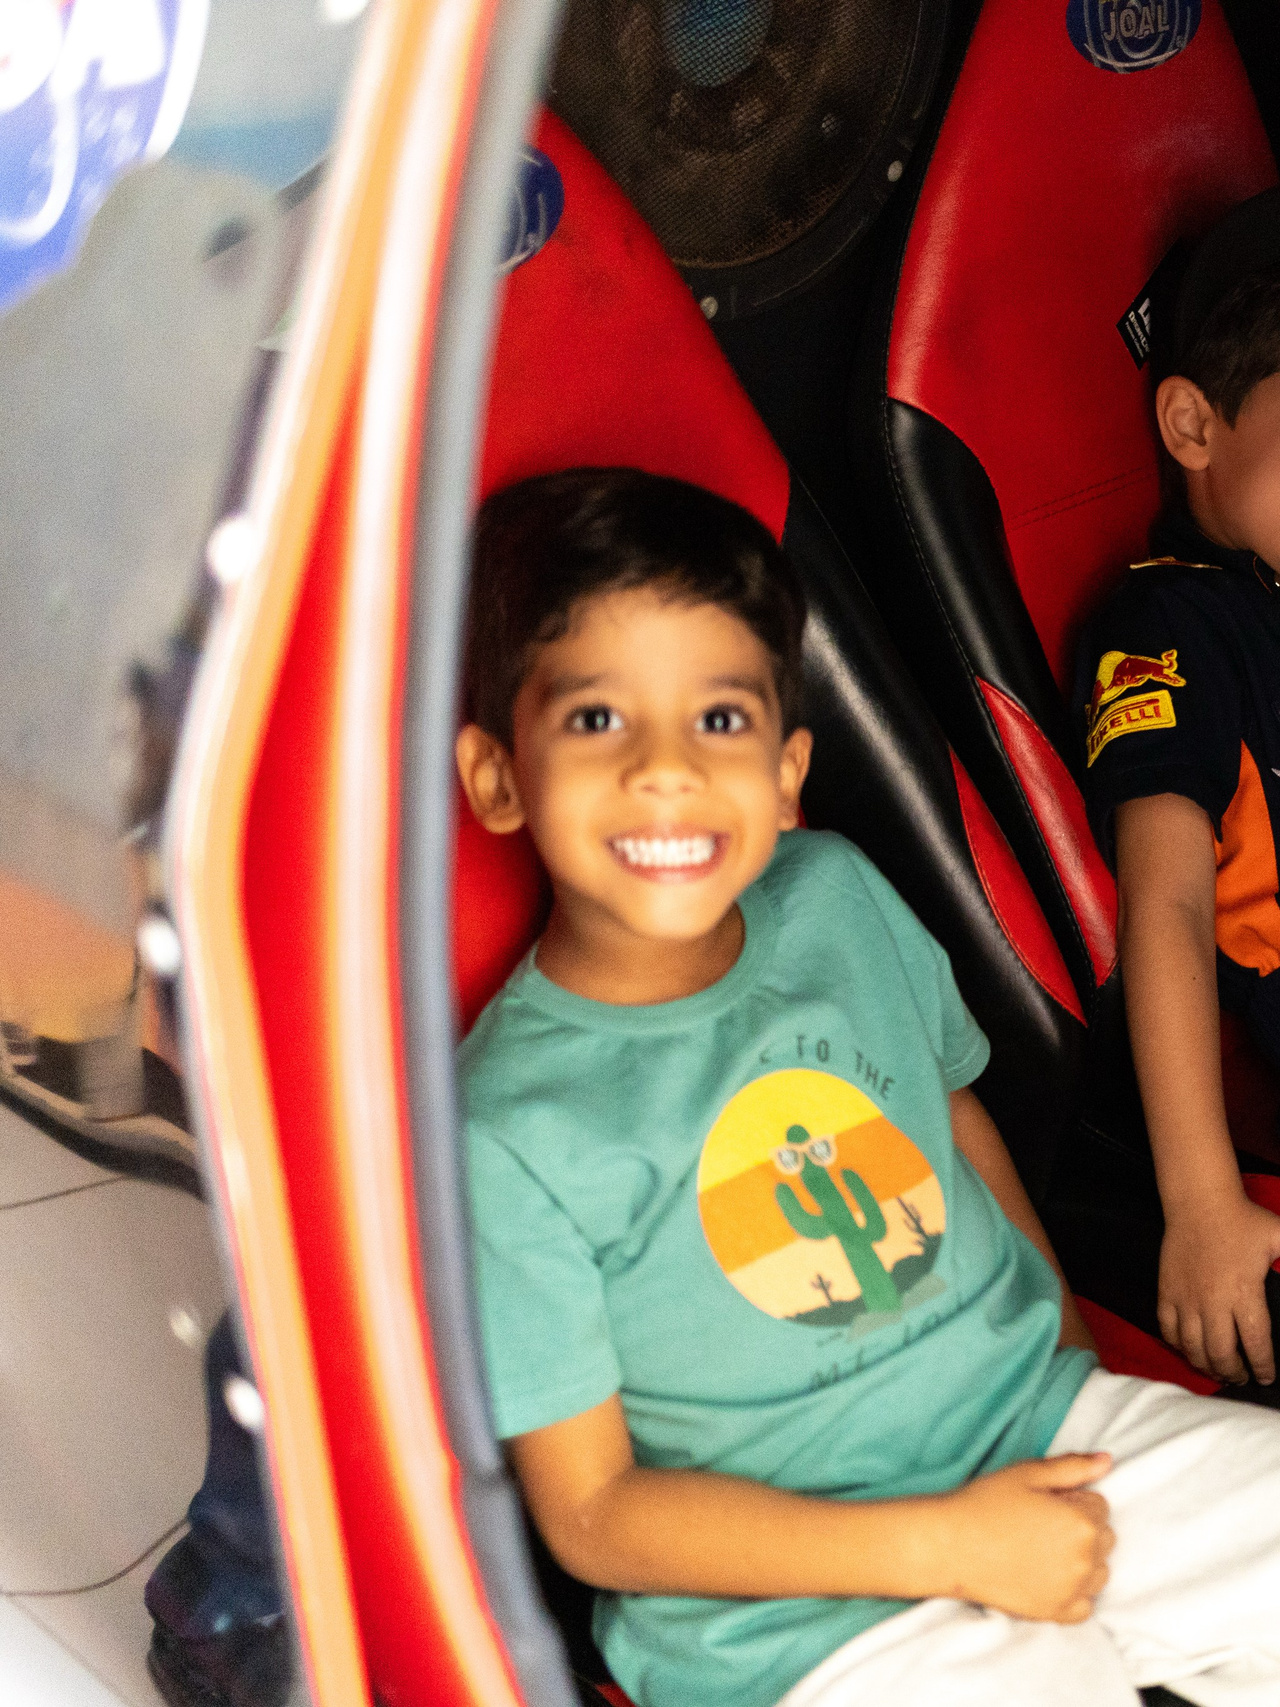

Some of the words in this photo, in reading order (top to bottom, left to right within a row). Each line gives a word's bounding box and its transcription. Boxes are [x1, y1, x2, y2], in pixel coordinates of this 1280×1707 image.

[1103, 4, 1170, 41] JOAL
[796, 1033, 831, 1063] TO
[854, 1049, 896, 1101] THE
